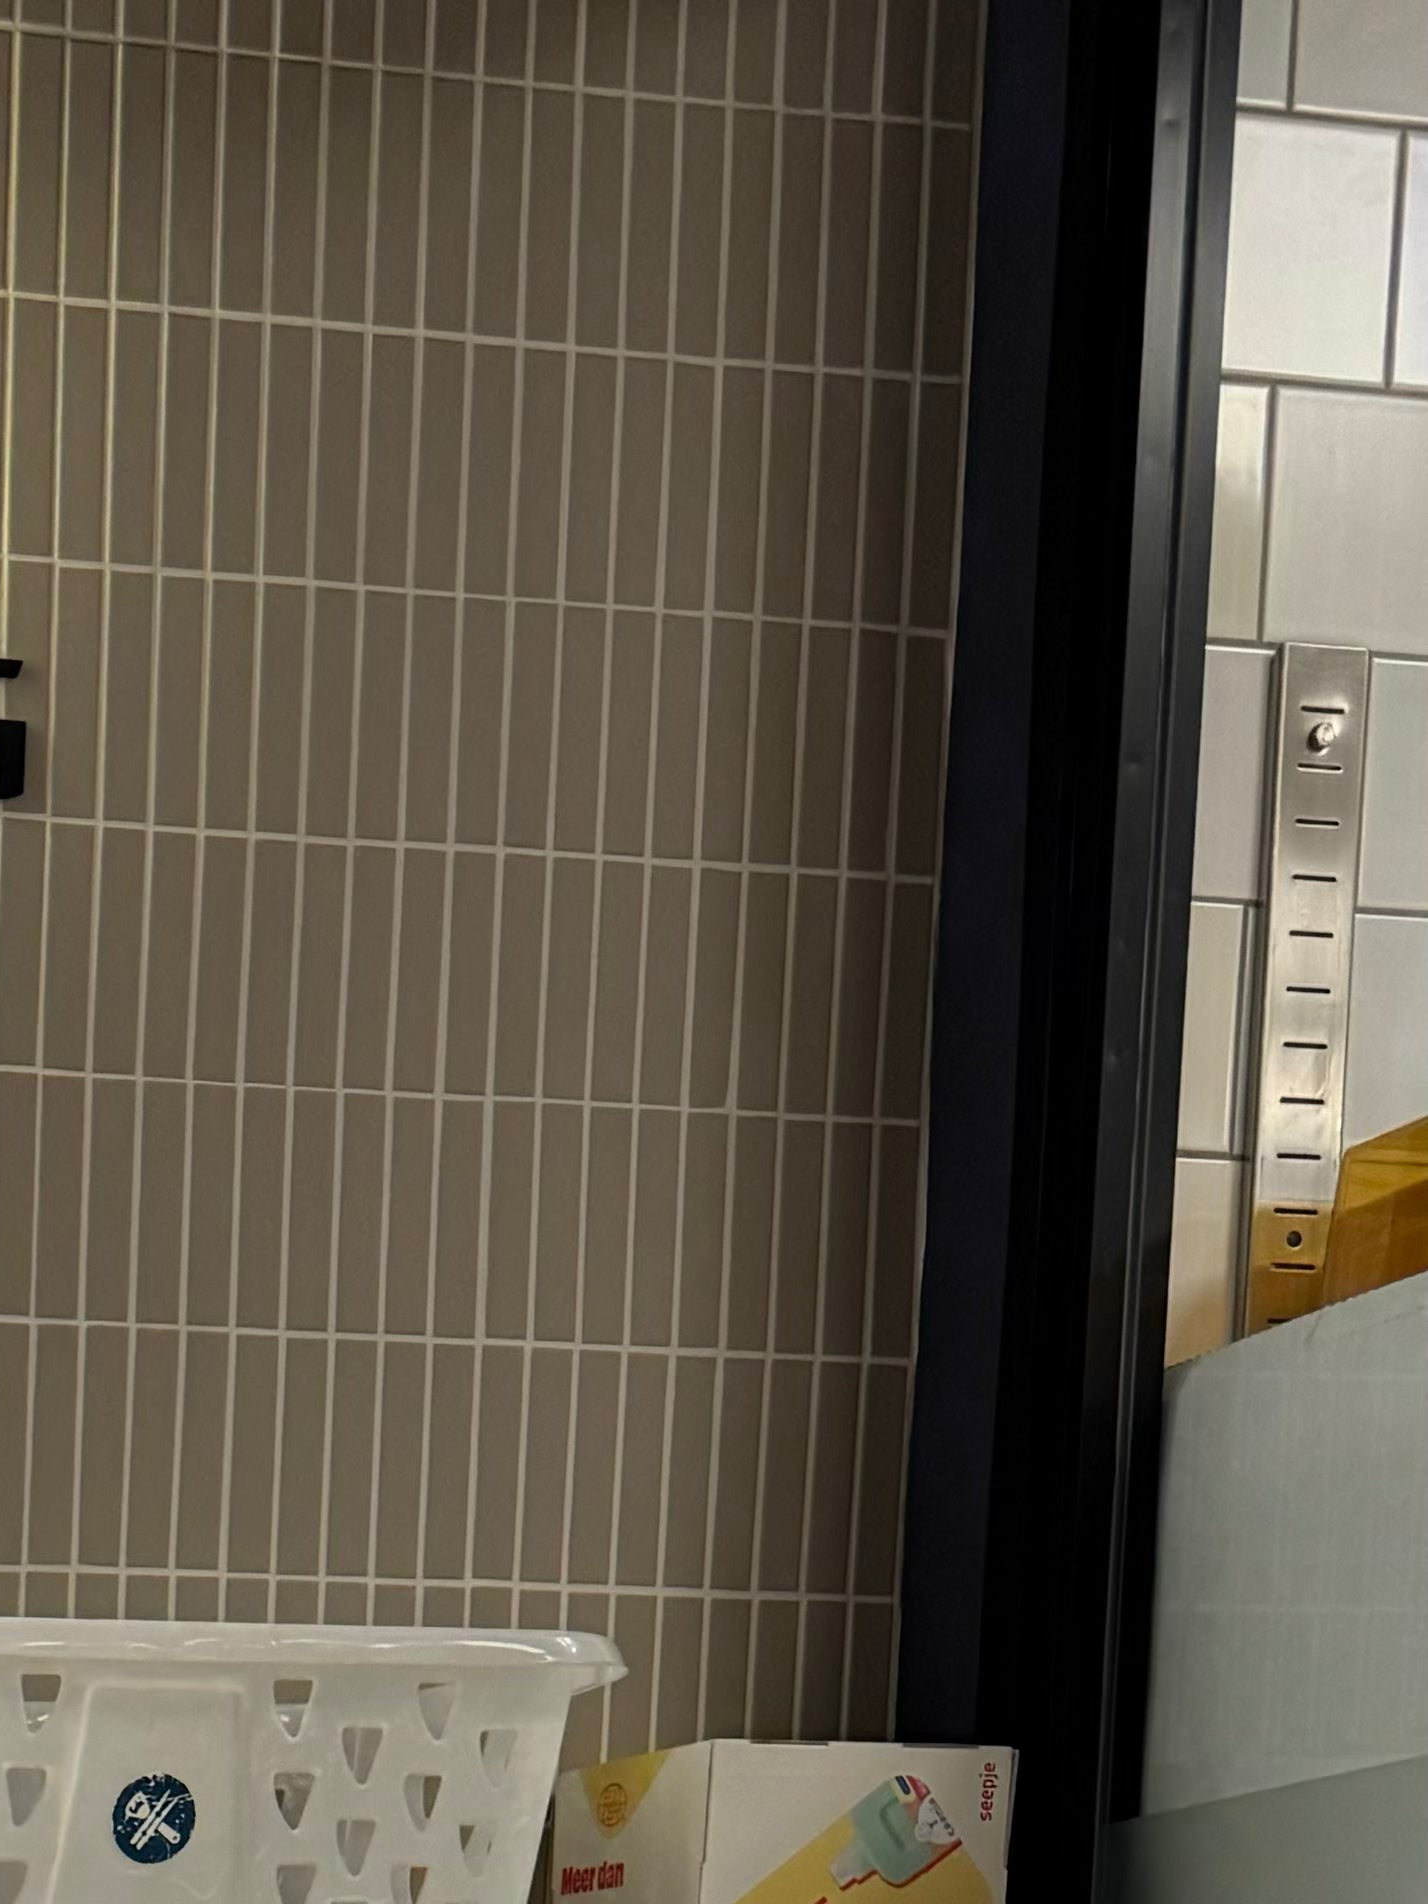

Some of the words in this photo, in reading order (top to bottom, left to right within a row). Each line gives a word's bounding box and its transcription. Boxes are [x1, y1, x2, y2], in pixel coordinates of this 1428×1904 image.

[980, 1762, 999, 1821] seepje
[561, 1866, 595, 1895] Meer
[598, 1861, 624, 1890] dan
